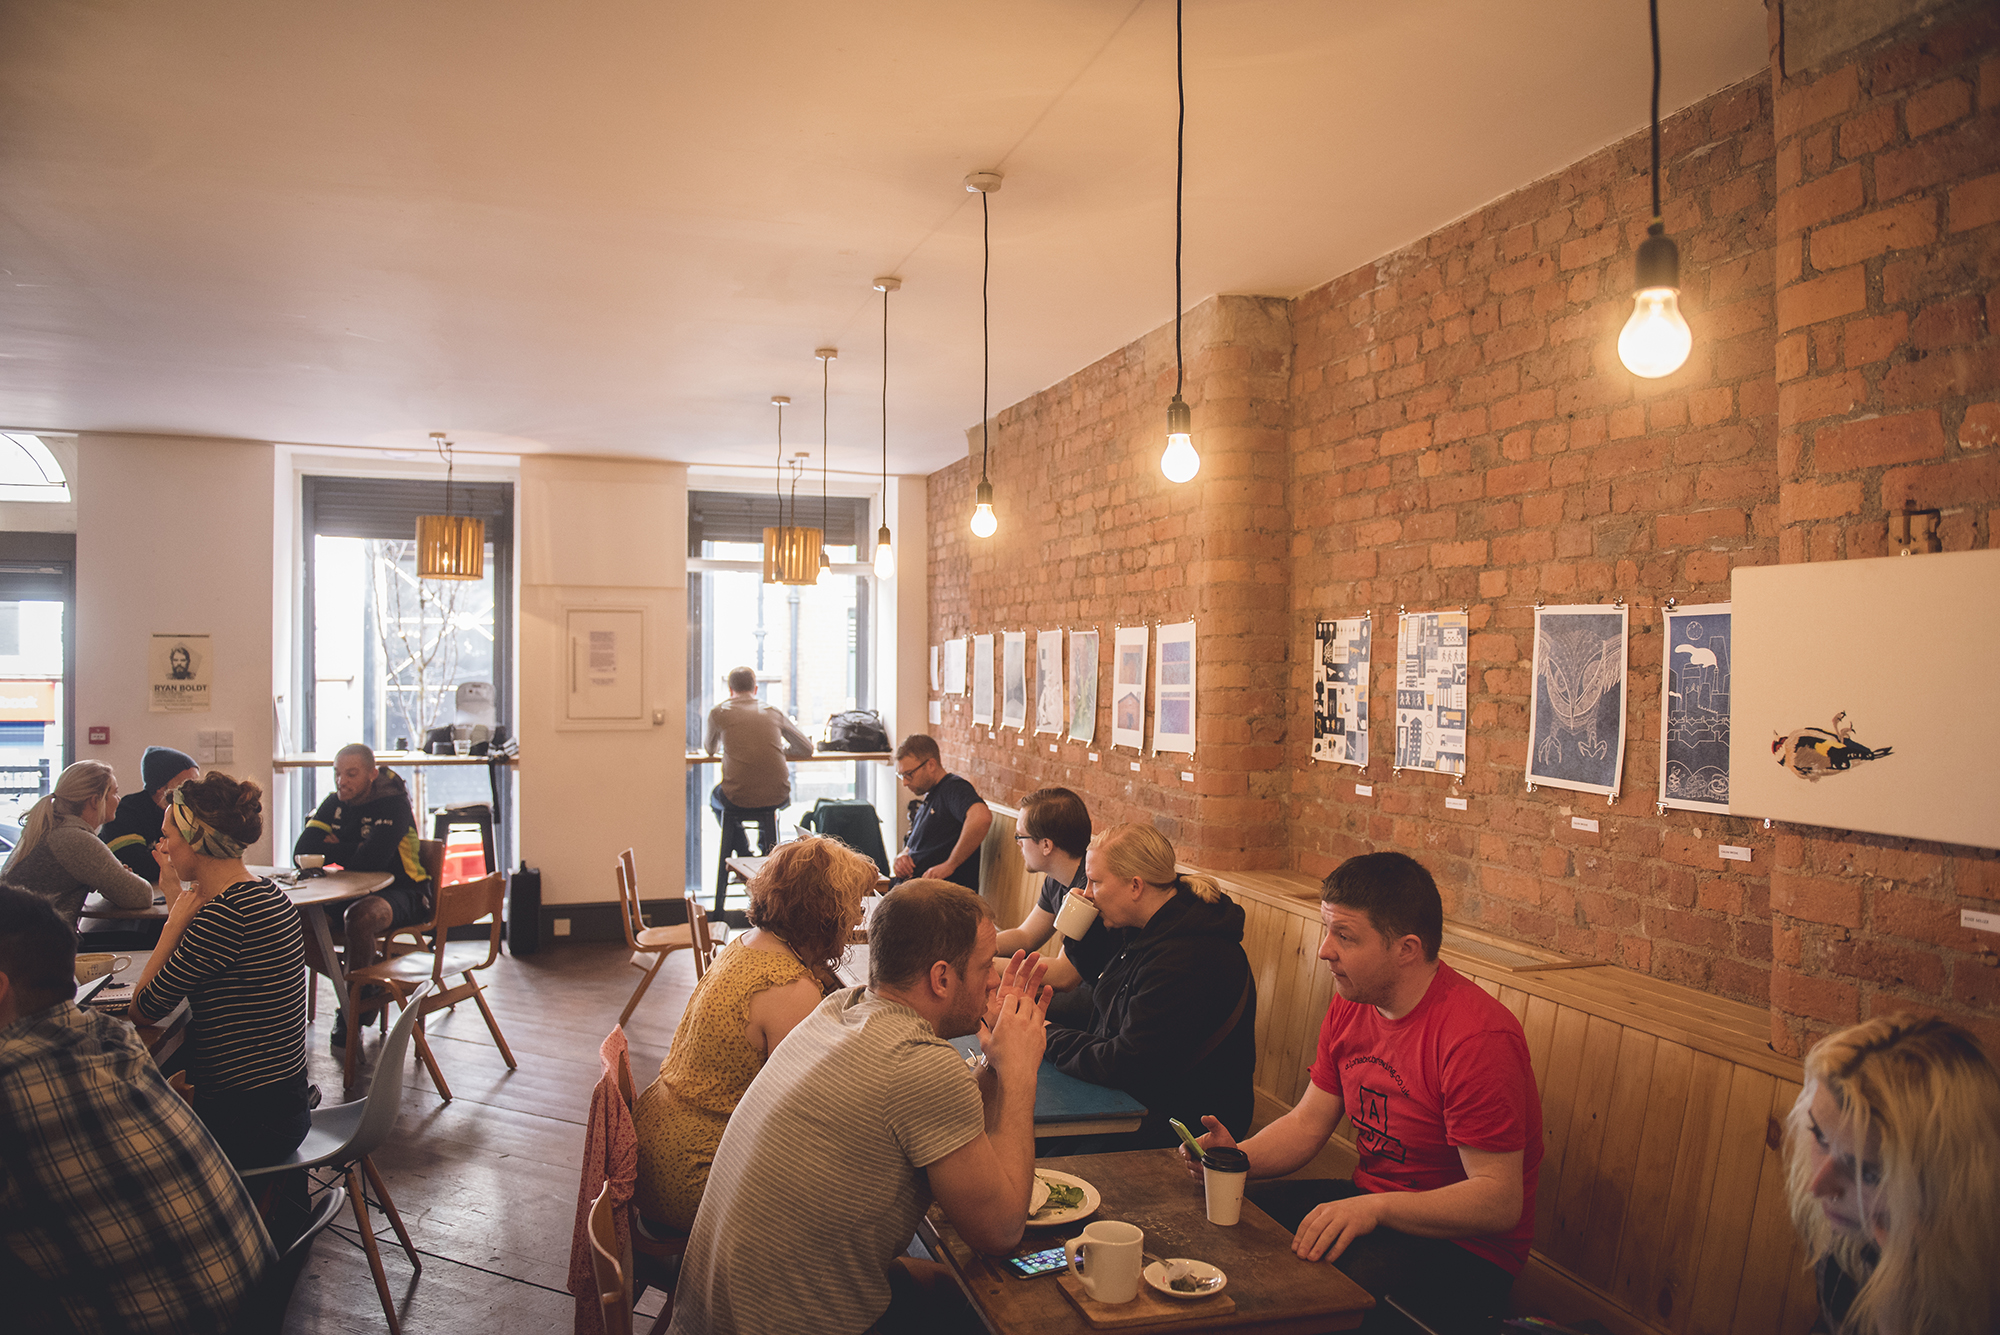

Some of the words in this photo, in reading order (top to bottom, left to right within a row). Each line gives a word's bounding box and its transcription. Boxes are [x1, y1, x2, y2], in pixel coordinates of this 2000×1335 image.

[154, 684, 177, 692] RYAN
[179, 684, 207, 692] BOLDT
[1369, 1098, 1380, 1124] A
